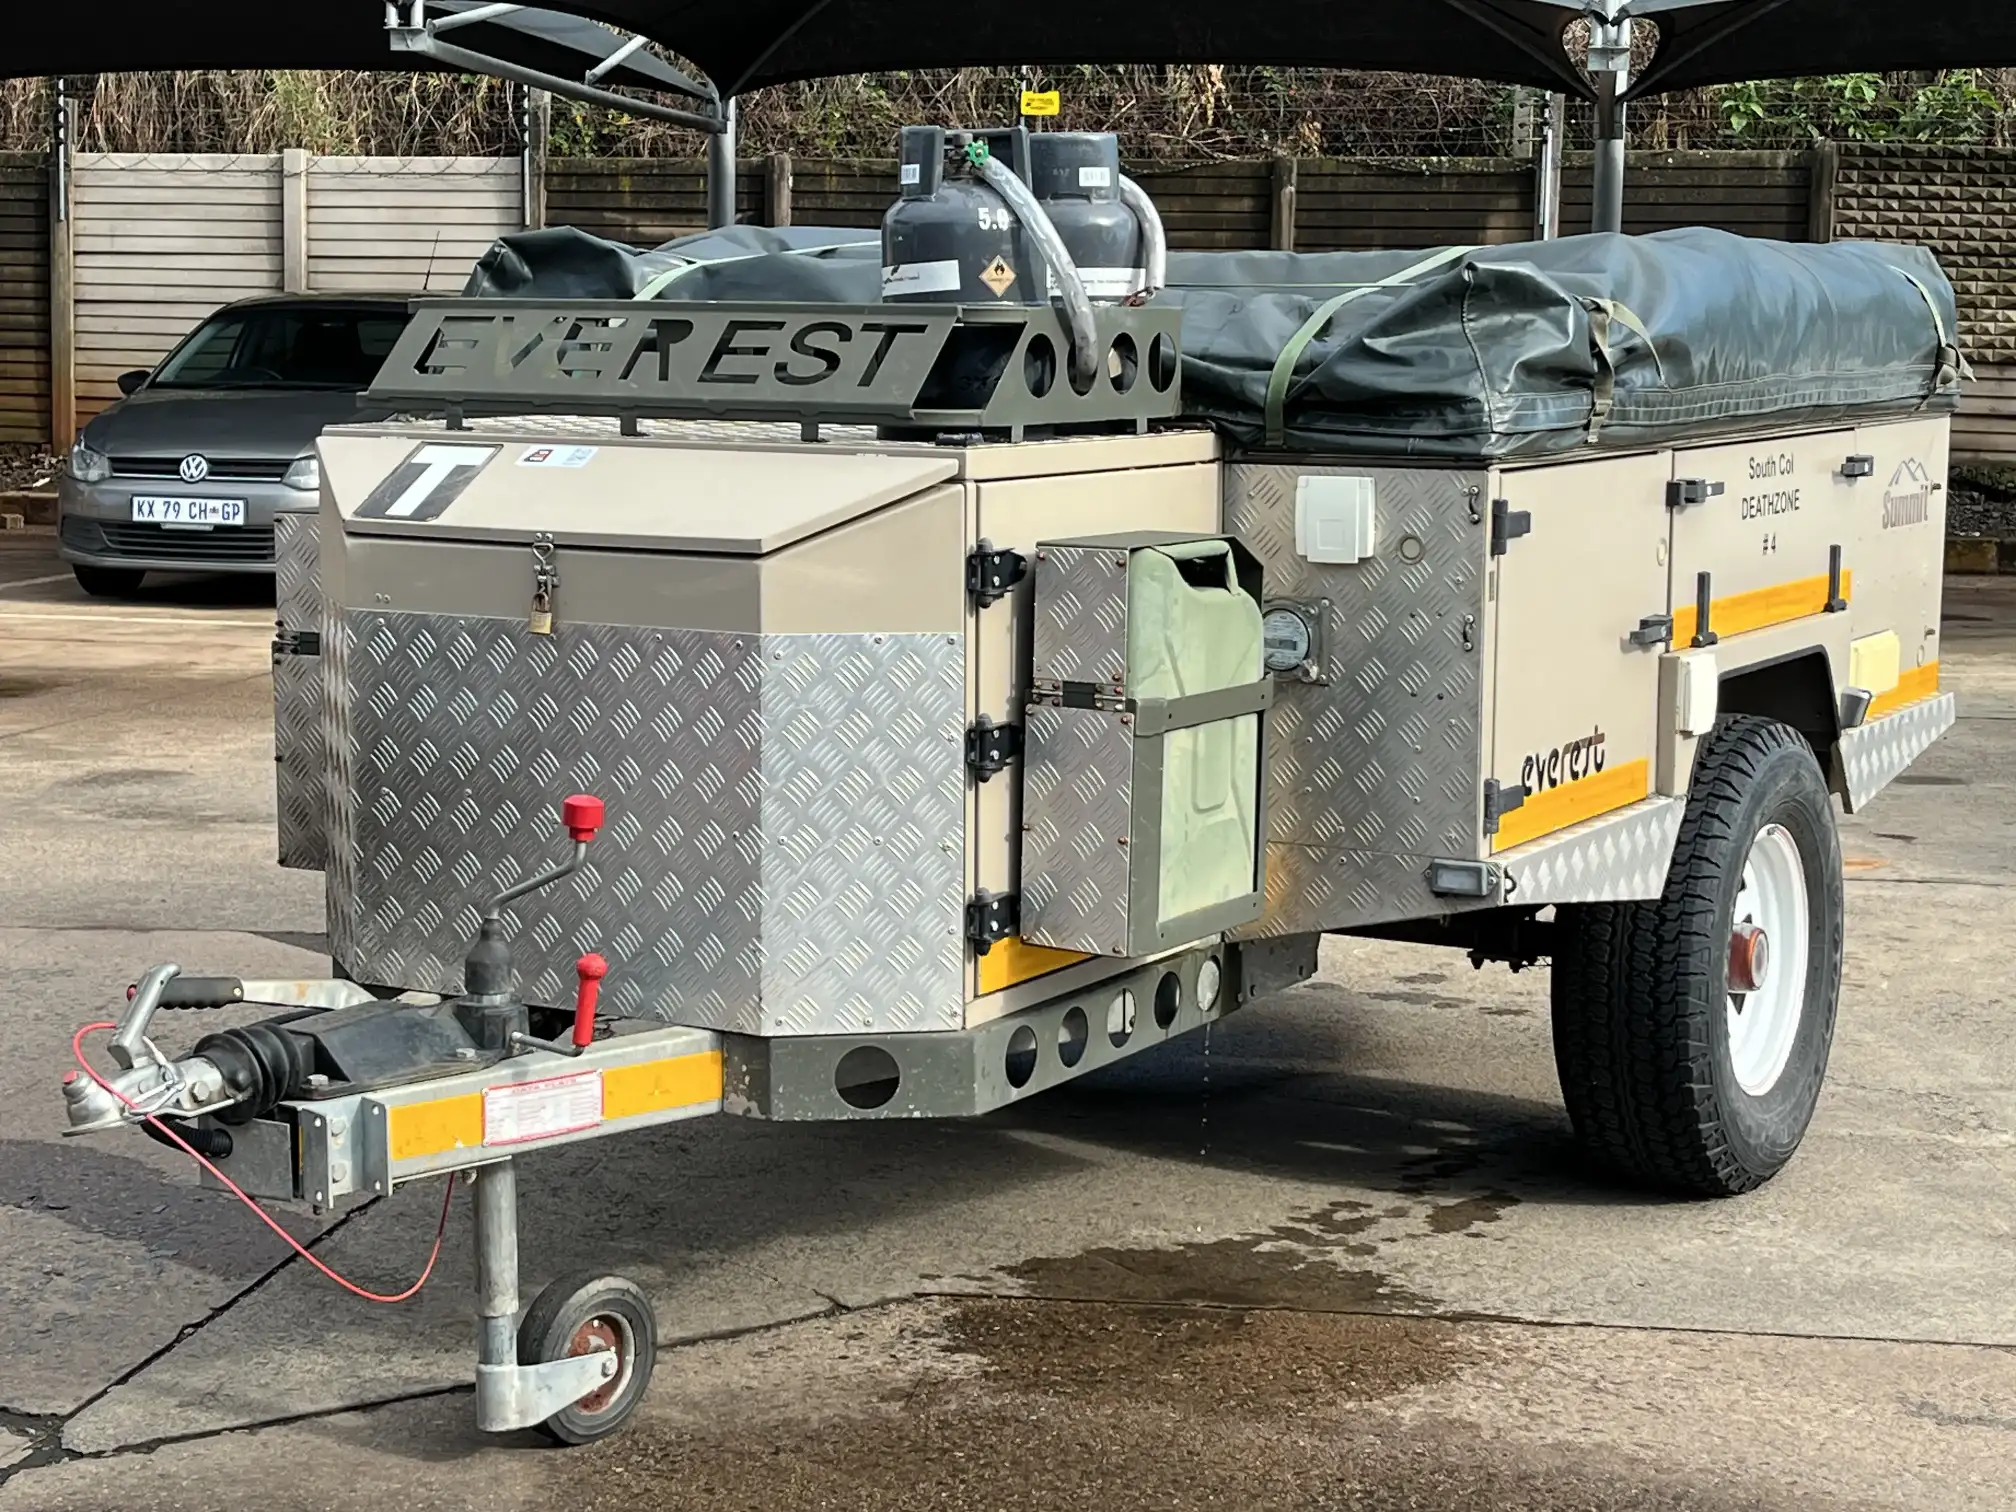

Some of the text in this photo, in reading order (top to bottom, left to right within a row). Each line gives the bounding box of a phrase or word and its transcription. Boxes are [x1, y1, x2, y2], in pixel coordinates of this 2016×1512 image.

[413, 315, 929, 388] EVEREST
[1749, 452, 1794, 480] South Col
[137, 499, 240, 521] KX 79 CH GP
[1741, 488, 1800, 521] DEATHZONE
